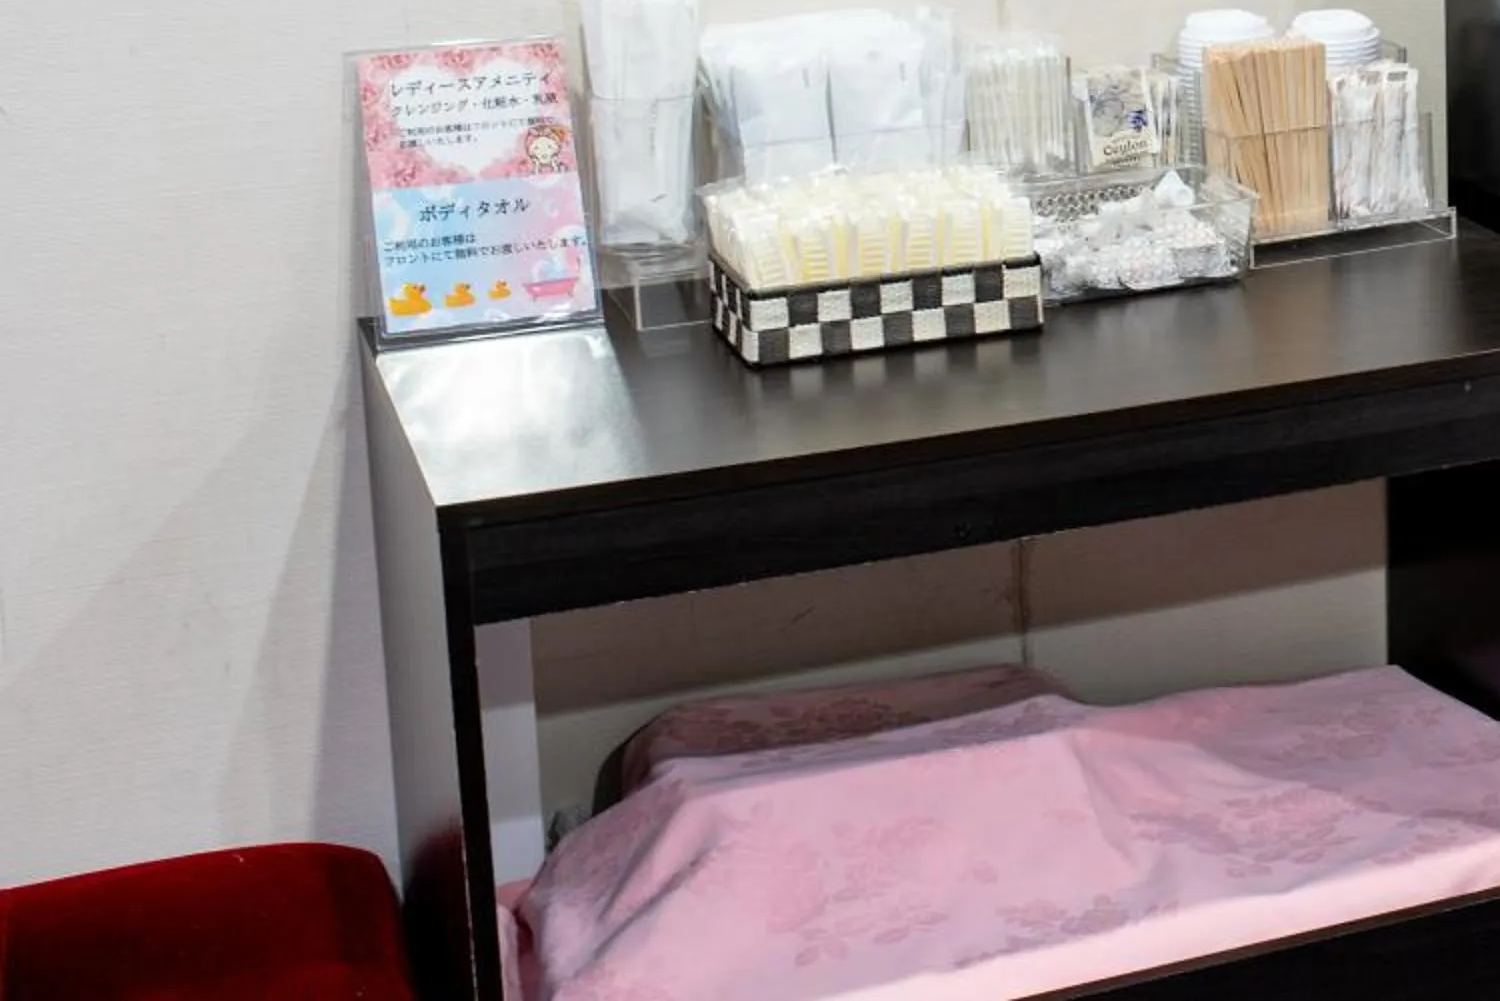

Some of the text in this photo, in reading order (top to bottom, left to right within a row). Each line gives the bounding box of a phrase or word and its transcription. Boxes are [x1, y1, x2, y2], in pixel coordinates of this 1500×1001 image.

[390, 70, 552, 98] レディースアメニティ
[419, 199, 530, 223] ボディタオル
